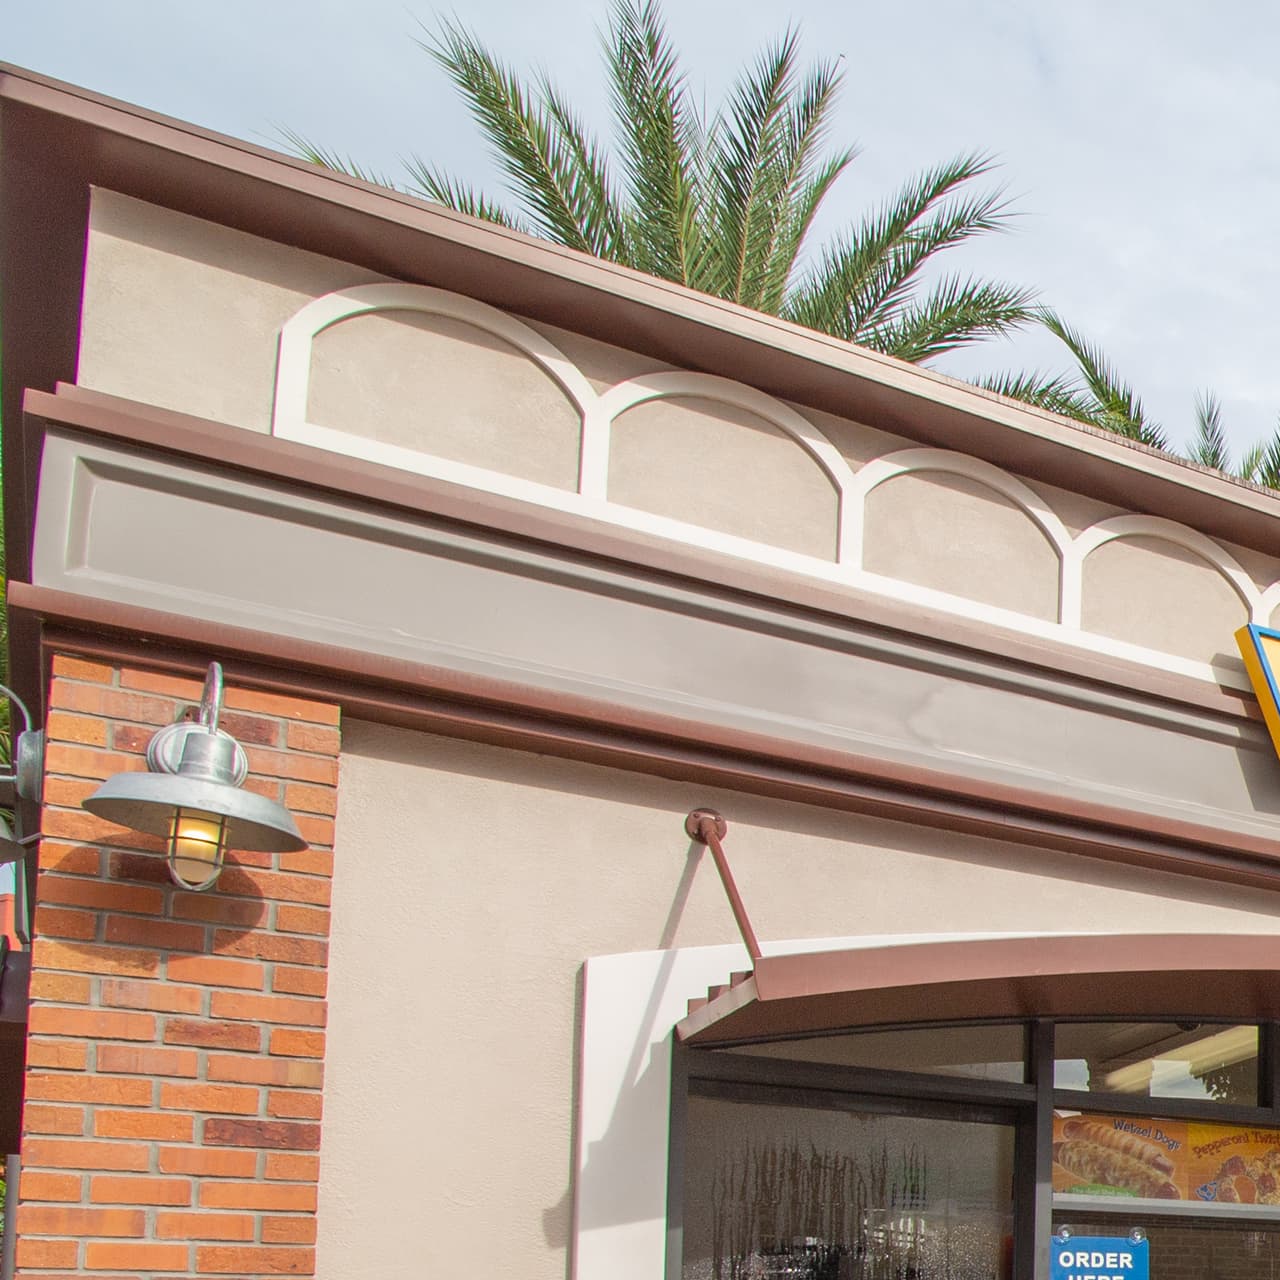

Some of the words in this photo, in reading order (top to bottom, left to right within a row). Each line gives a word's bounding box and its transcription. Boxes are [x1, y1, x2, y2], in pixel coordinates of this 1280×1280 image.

[1113, 1119, 1153, 1138] Wetzel
[1154, 1128, 1182, 1152] Dogs
[1192, 1132, 1249, 1159] Pepperoni
[1059, 1251, 1133, 1269] ORDER
